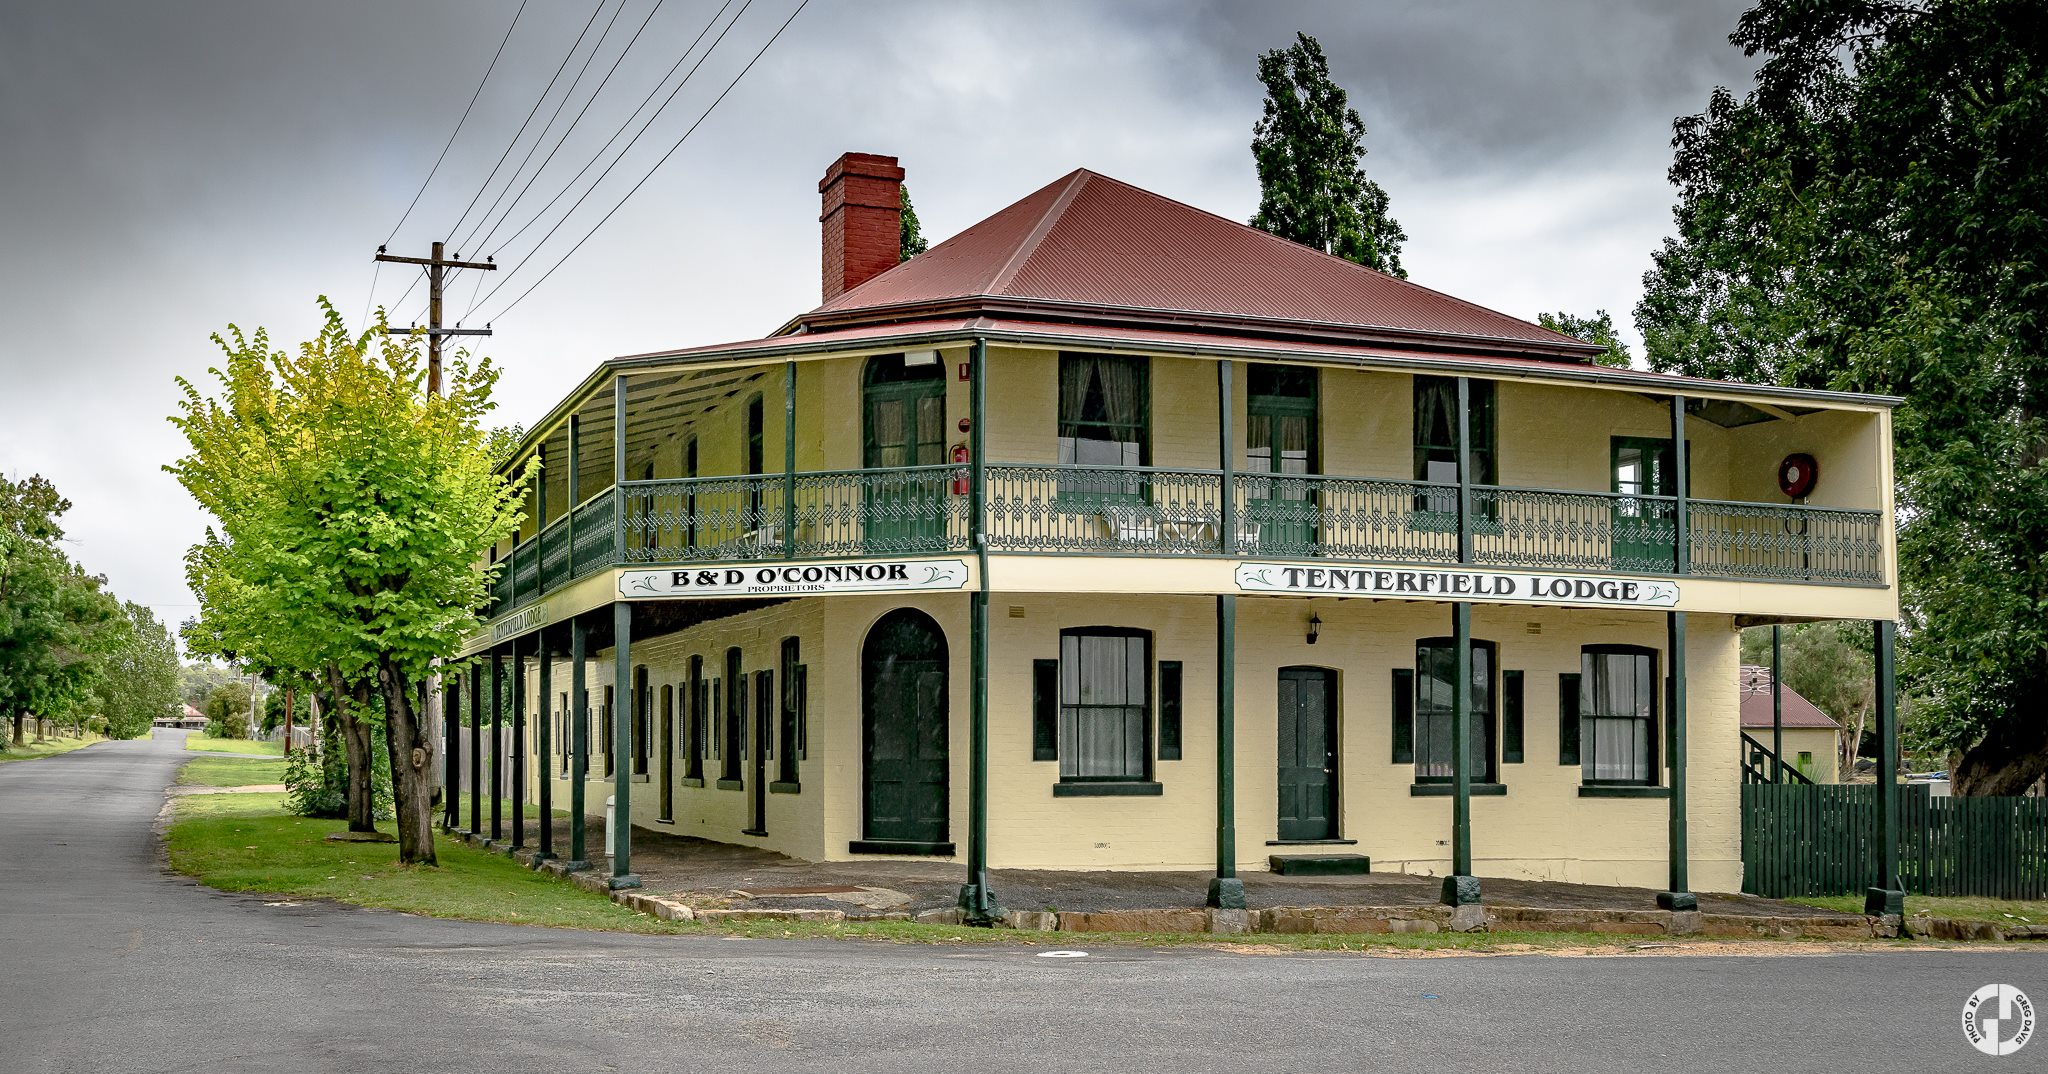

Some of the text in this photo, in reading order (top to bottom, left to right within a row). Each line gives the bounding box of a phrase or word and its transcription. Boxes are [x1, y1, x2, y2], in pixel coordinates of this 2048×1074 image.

[755, 564, 909, 584] O'CONNOR
[1282, 567, 1640, 601] TENTERFIELD LODGE
[747, 584, 825, 592] PROPRIETORS
[523, 606, 541, 627] LODGE
